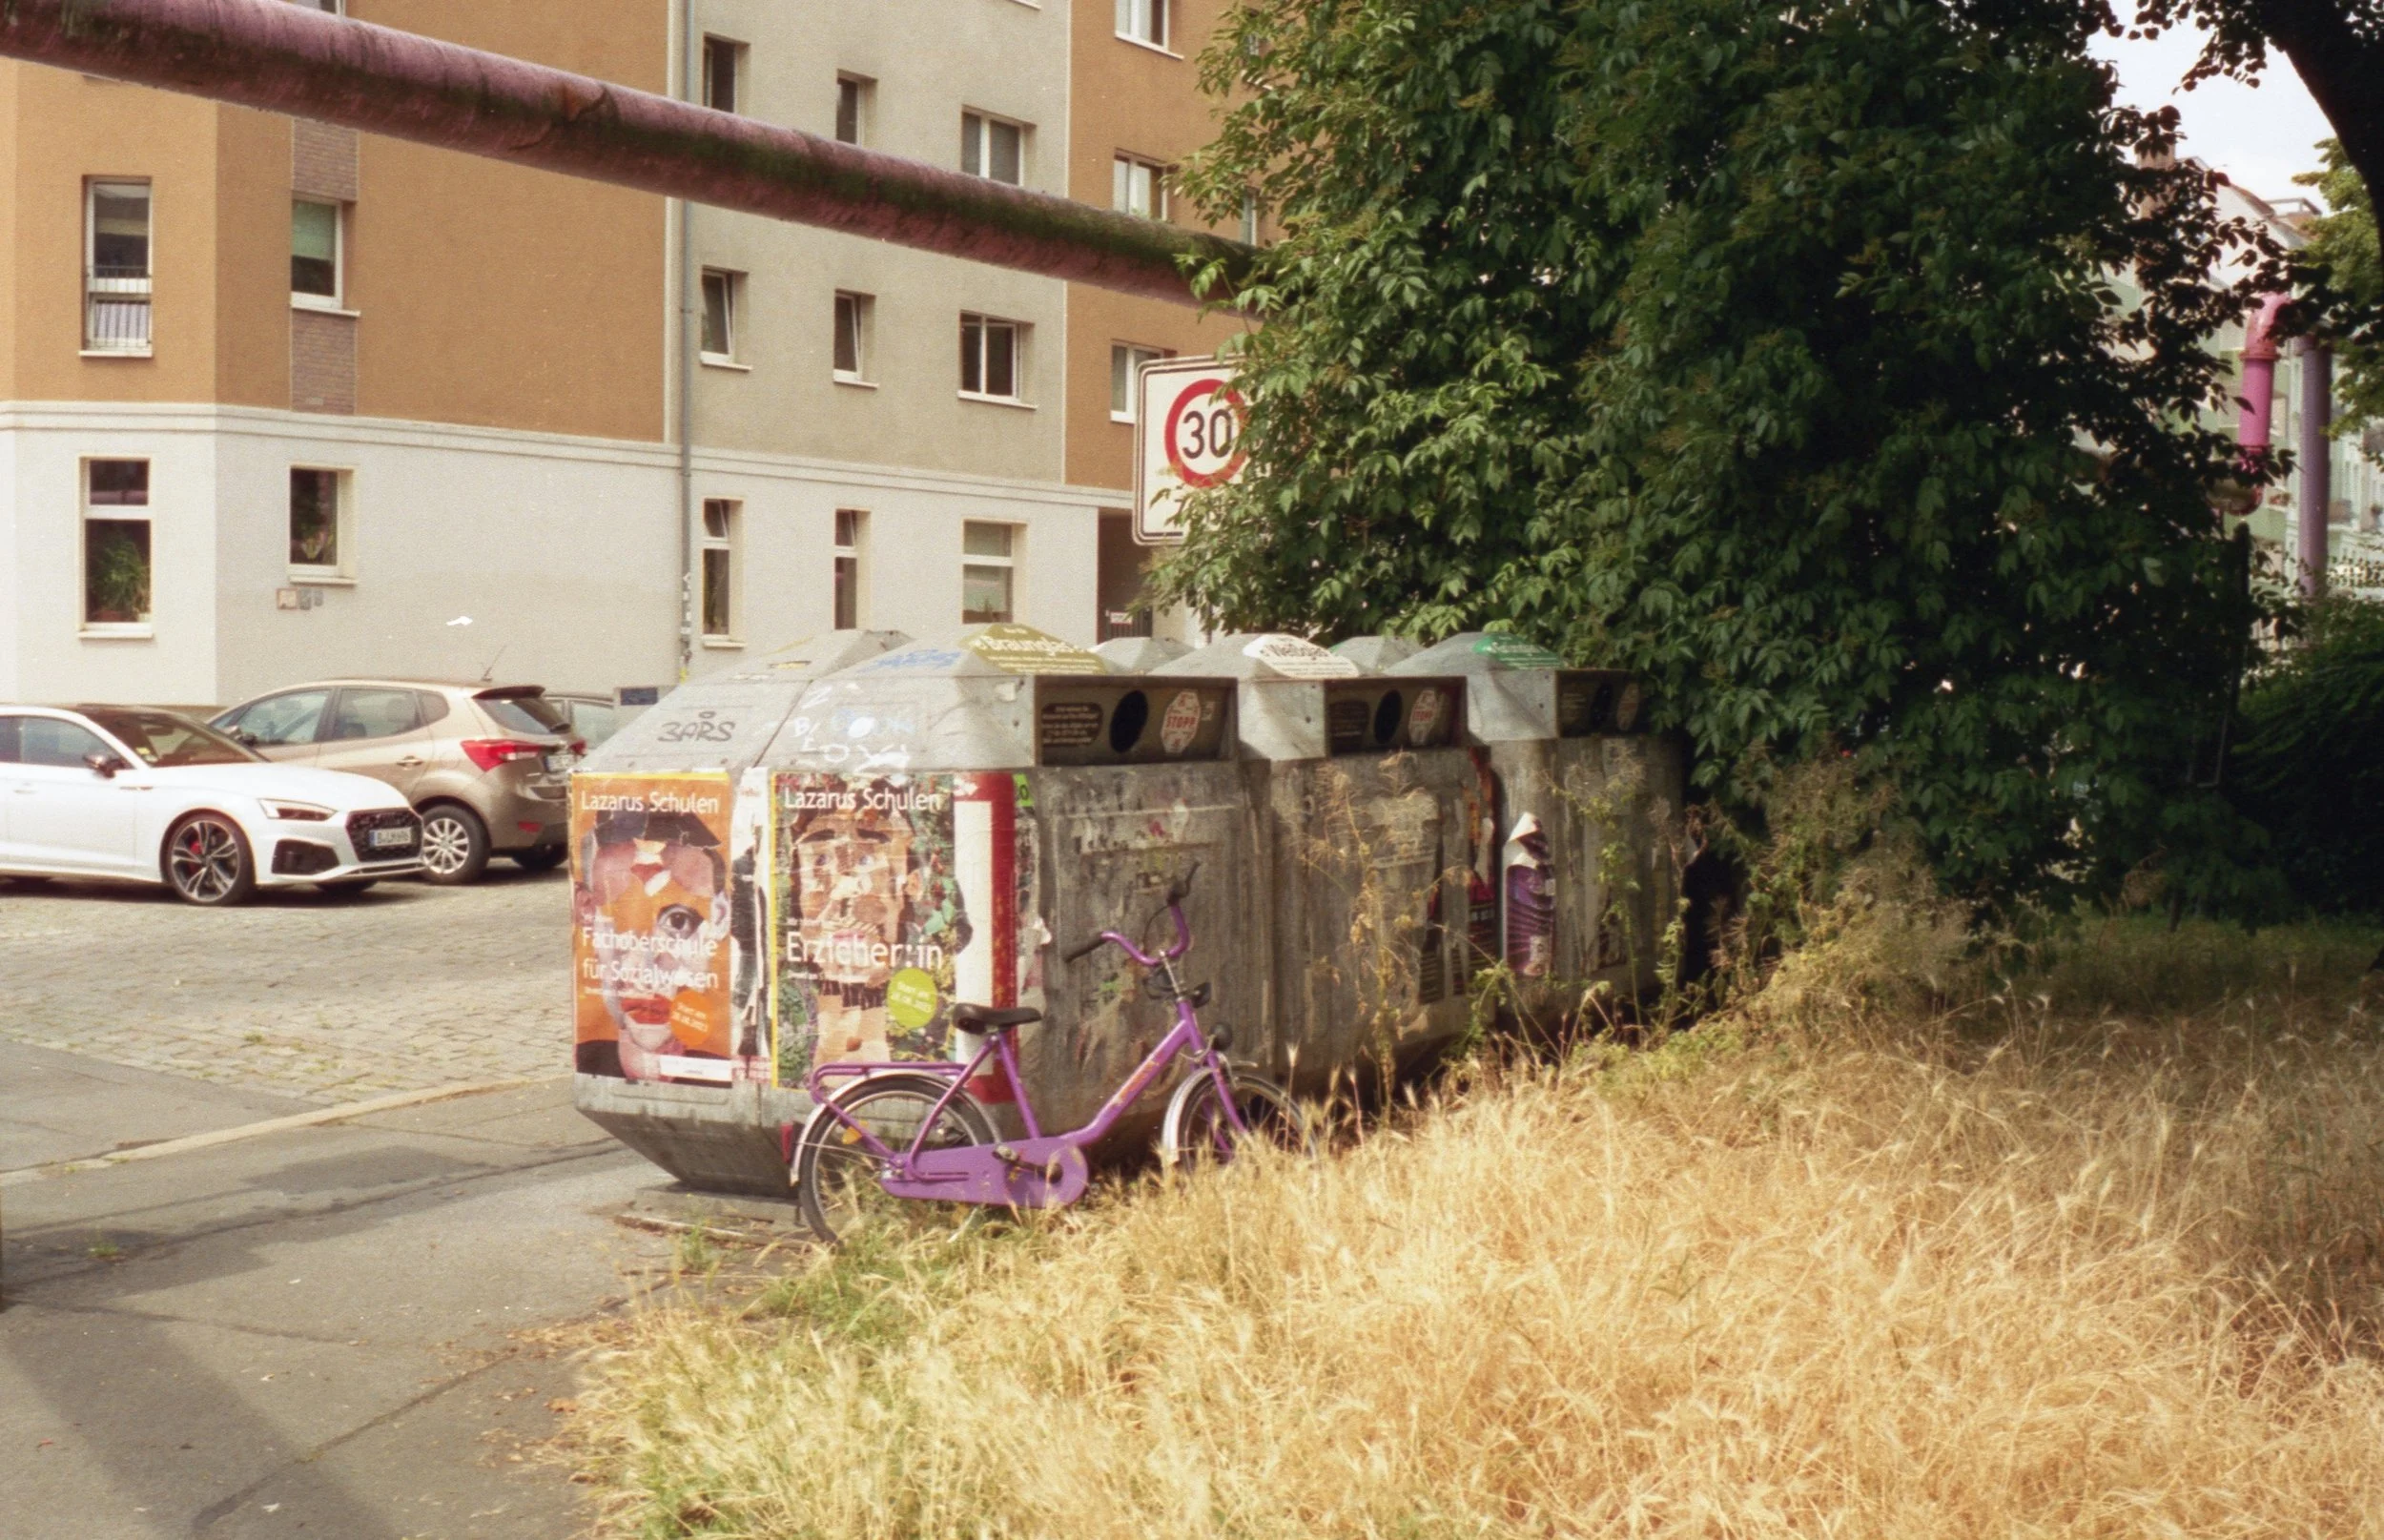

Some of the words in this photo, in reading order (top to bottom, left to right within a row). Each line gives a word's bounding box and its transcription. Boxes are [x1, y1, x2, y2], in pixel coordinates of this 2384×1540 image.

[1182, 409, 1232, 459] 30
[581, 791, 645, 812] Lazarus
[648, 791, 720, 814] Schulen
[784, 787, 856, 810] Lazarus
[863, 788, 941, 811] Schulen
[582, 926, 718, 957] Fachoberschule
[787, 931, 943, 970] Erzieher:in
[583, 957, 607, 979] für
